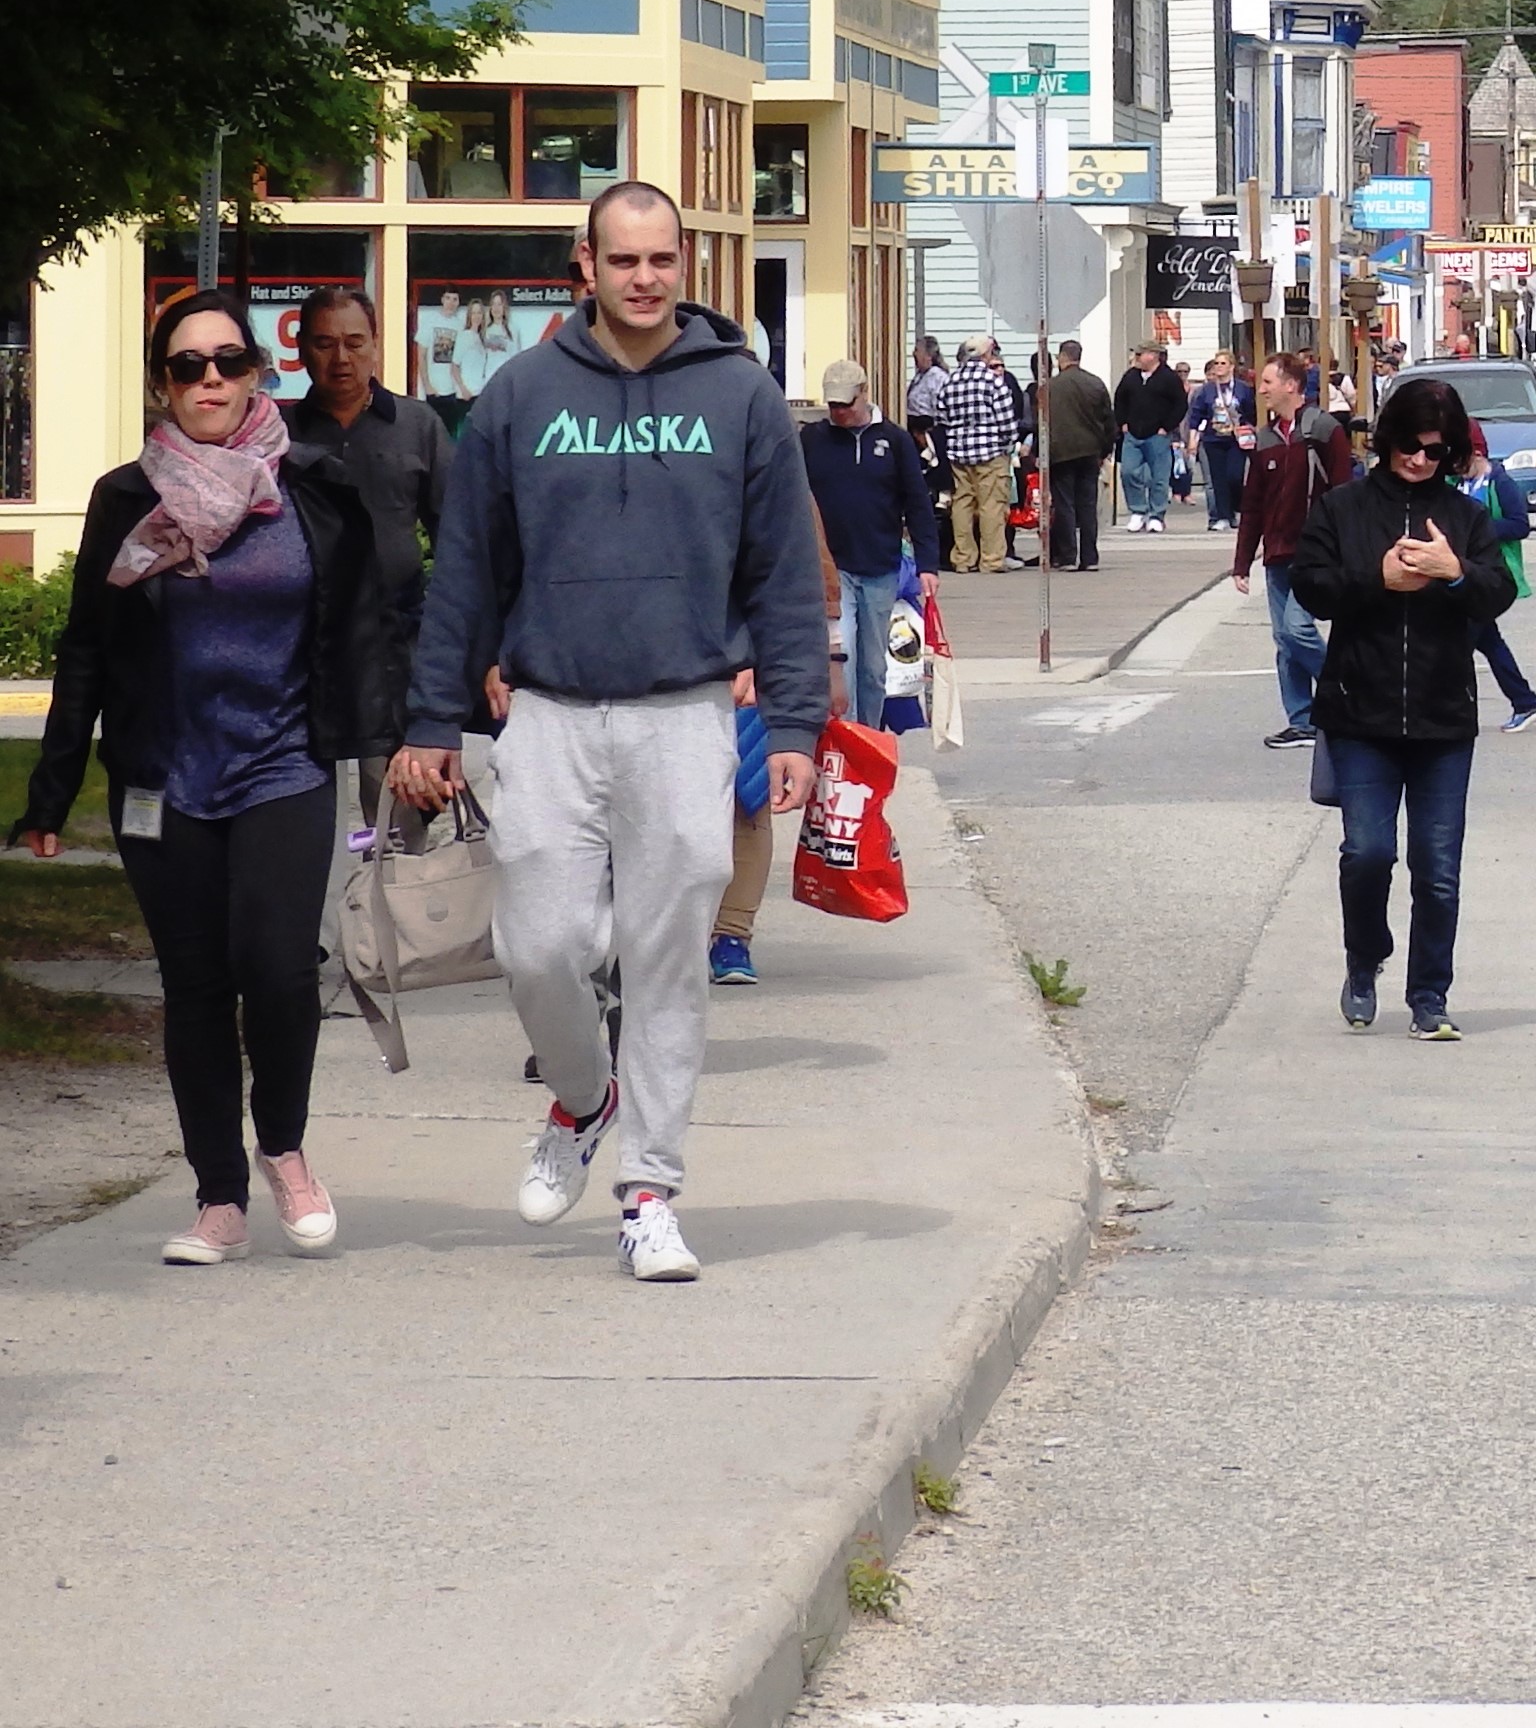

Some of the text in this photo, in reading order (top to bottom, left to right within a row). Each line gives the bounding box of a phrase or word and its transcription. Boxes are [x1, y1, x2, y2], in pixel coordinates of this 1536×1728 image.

[1037, 73, 1068, 93] AVE
[929, 154, 1097, 169] ALAA
[903, 172, 1018, 197] SHIR
[1354, 200, 1427, 214] EWELERS
[1491, 253, 1527, 269] GEMS
[250, 285, 316, 300] Hat and Shir
[512, 287, 543, 302] Select
[534, 408, 713, 457] ALASKA
